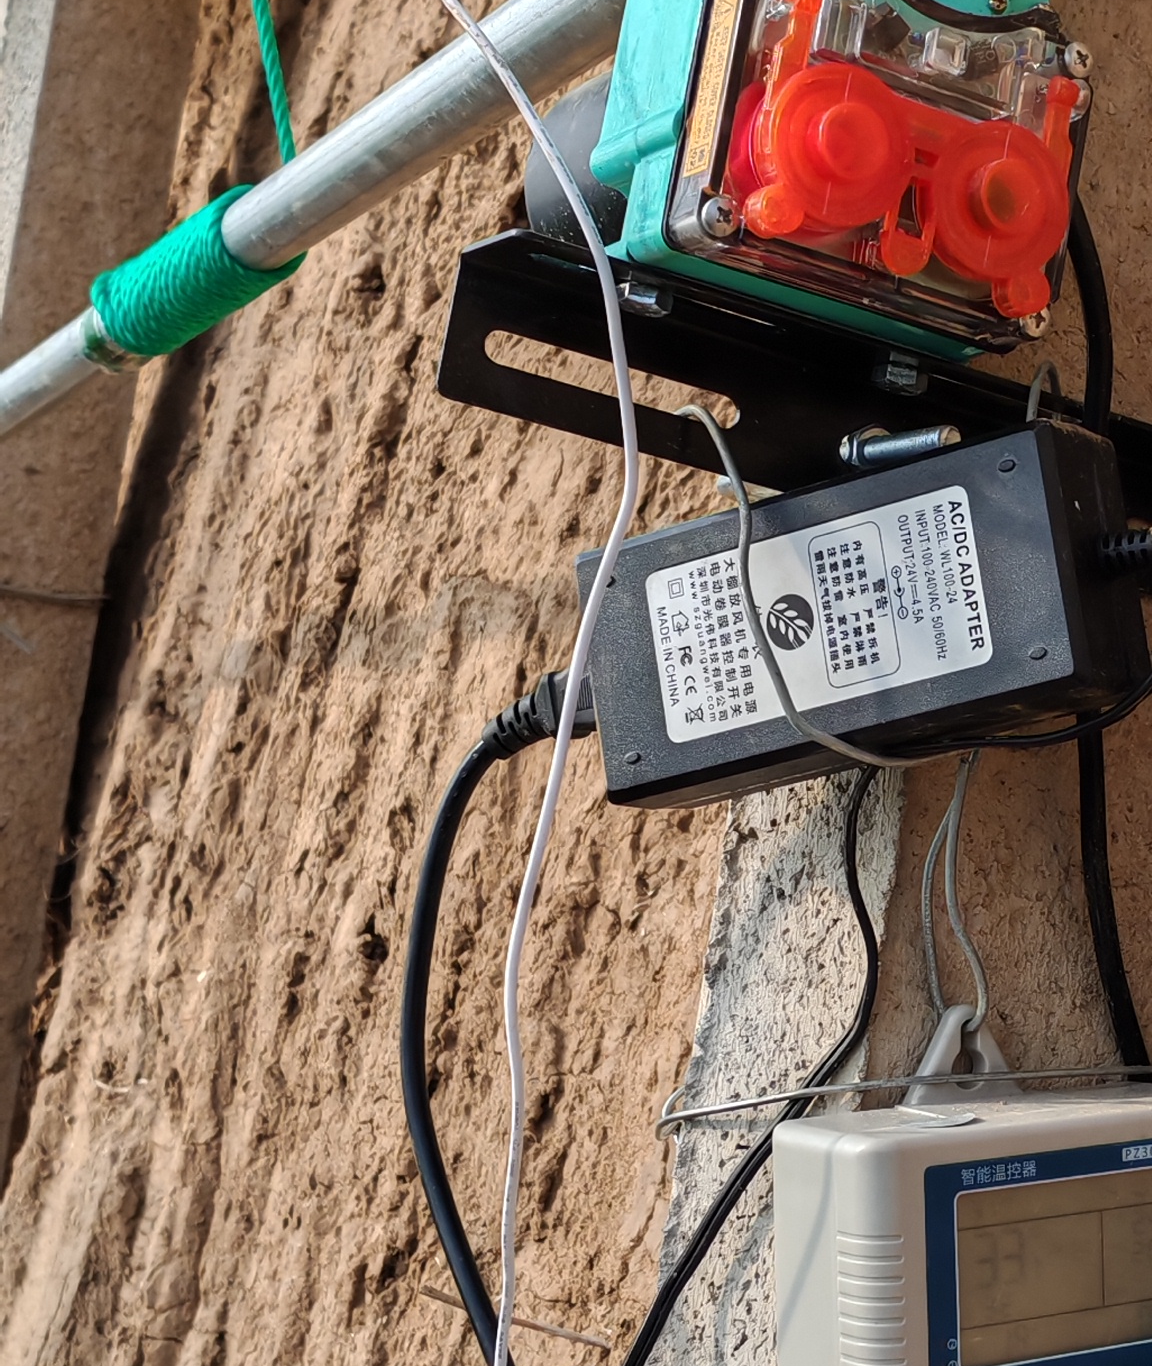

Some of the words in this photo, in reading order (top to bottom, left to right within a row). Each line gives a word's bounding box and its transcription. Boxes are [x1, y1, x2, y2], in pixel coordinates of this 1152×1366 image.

[947, 497, 970, 558] AC/DC
[838, 541, 857, 600] 注意防水
[938, 549, 958, 605] WL100-24
[655, 605, 672, 645] MADE
[850, 538, 870, 596] 内有高压
[861, 606, 880, 665] 严禁拆机
[957, 559, 985, 651] ADAPTER
[661, 646, 674, 662] IN
[684, 569, 719, 723] wwwszguangwei.com
[693, 565, 731, 722] 深圳市光伟科技有限公司
[705, 560, 745, 718] 电动卷膜器控制开关
[720, 555, 760, 715] 大棚放风机专用电源
[930, 614, 949, 661] 50/60Hz
[663, 662, 681, 707] CHINA
[960, 1157, 1037, 1187] 智能温控器
